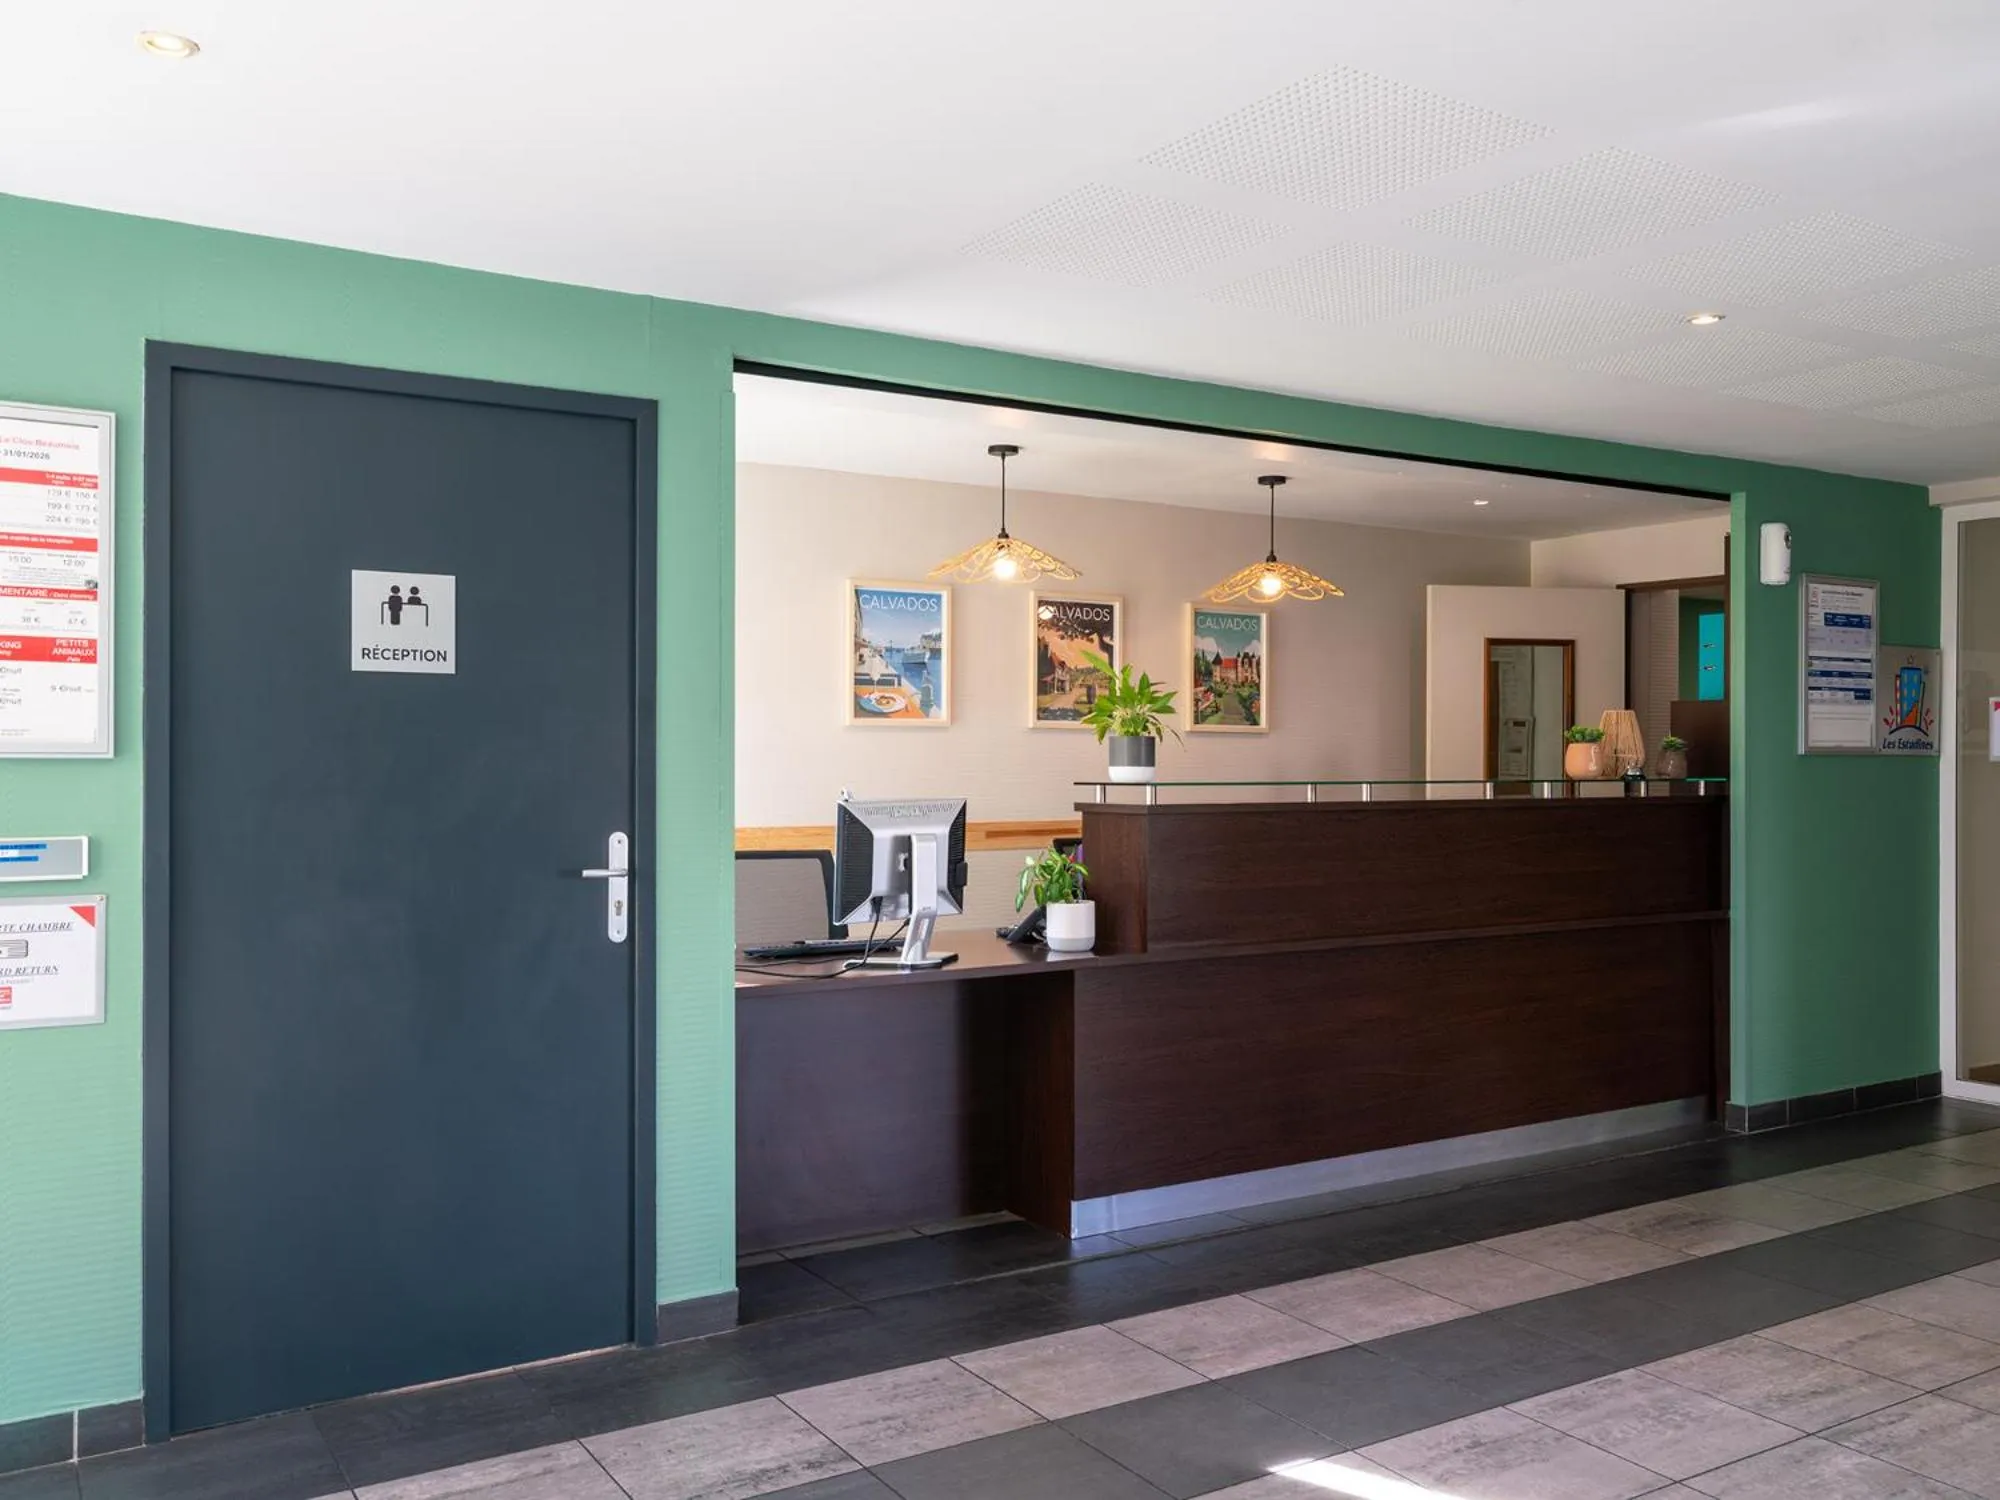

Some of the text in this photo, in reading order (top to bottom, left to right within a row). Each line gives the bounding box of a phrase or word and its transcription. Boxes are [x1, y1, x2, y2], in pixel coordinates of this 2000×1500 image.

[859, 594, 938, 612] CALVADOS
[1043, 605, 1111, 622] ALVADOS
[1197, 615, 1258, 632] CALVADOS
[55, 638, 89, 647] PETITS
[52, 647, 96, 656] ANIMAUX
[361, 643, 448, 662] RÉCEPTION
[1882, 738, 1896, 750] Les
[19, 921, 75, 932] CHAMBRE
[15, 965, 60, 975] RETURN
